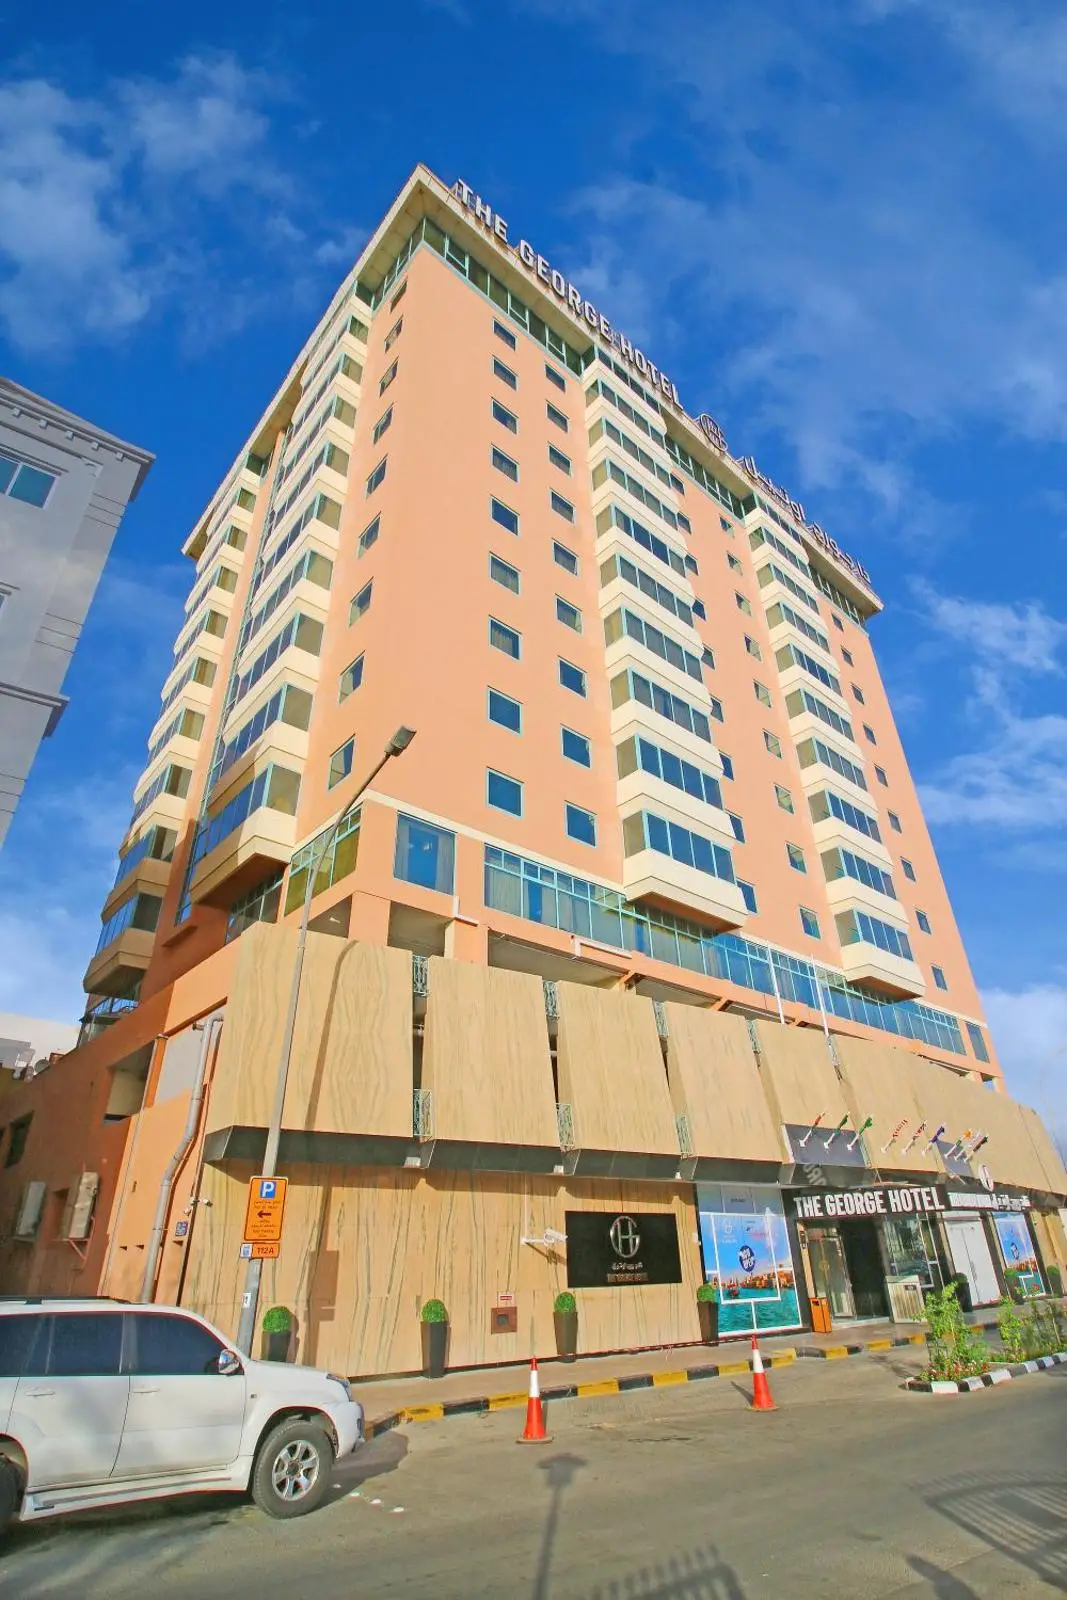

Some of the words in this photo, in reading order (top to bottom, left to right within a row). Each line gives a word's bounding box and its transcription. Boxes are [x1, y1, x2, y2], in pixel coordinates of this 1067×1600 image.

[456, 178, 508, 243] THE
[519, 239, 613, 341] GEORGE
[619, 333, 684, 410] HOTEL
[262, 1181, 275, 1198] P
[793, 1195, 824, 1218] THE
[825, 1190, 888, 1216] GEORGE
[888, 1186, 945, 1213] HOTEL
